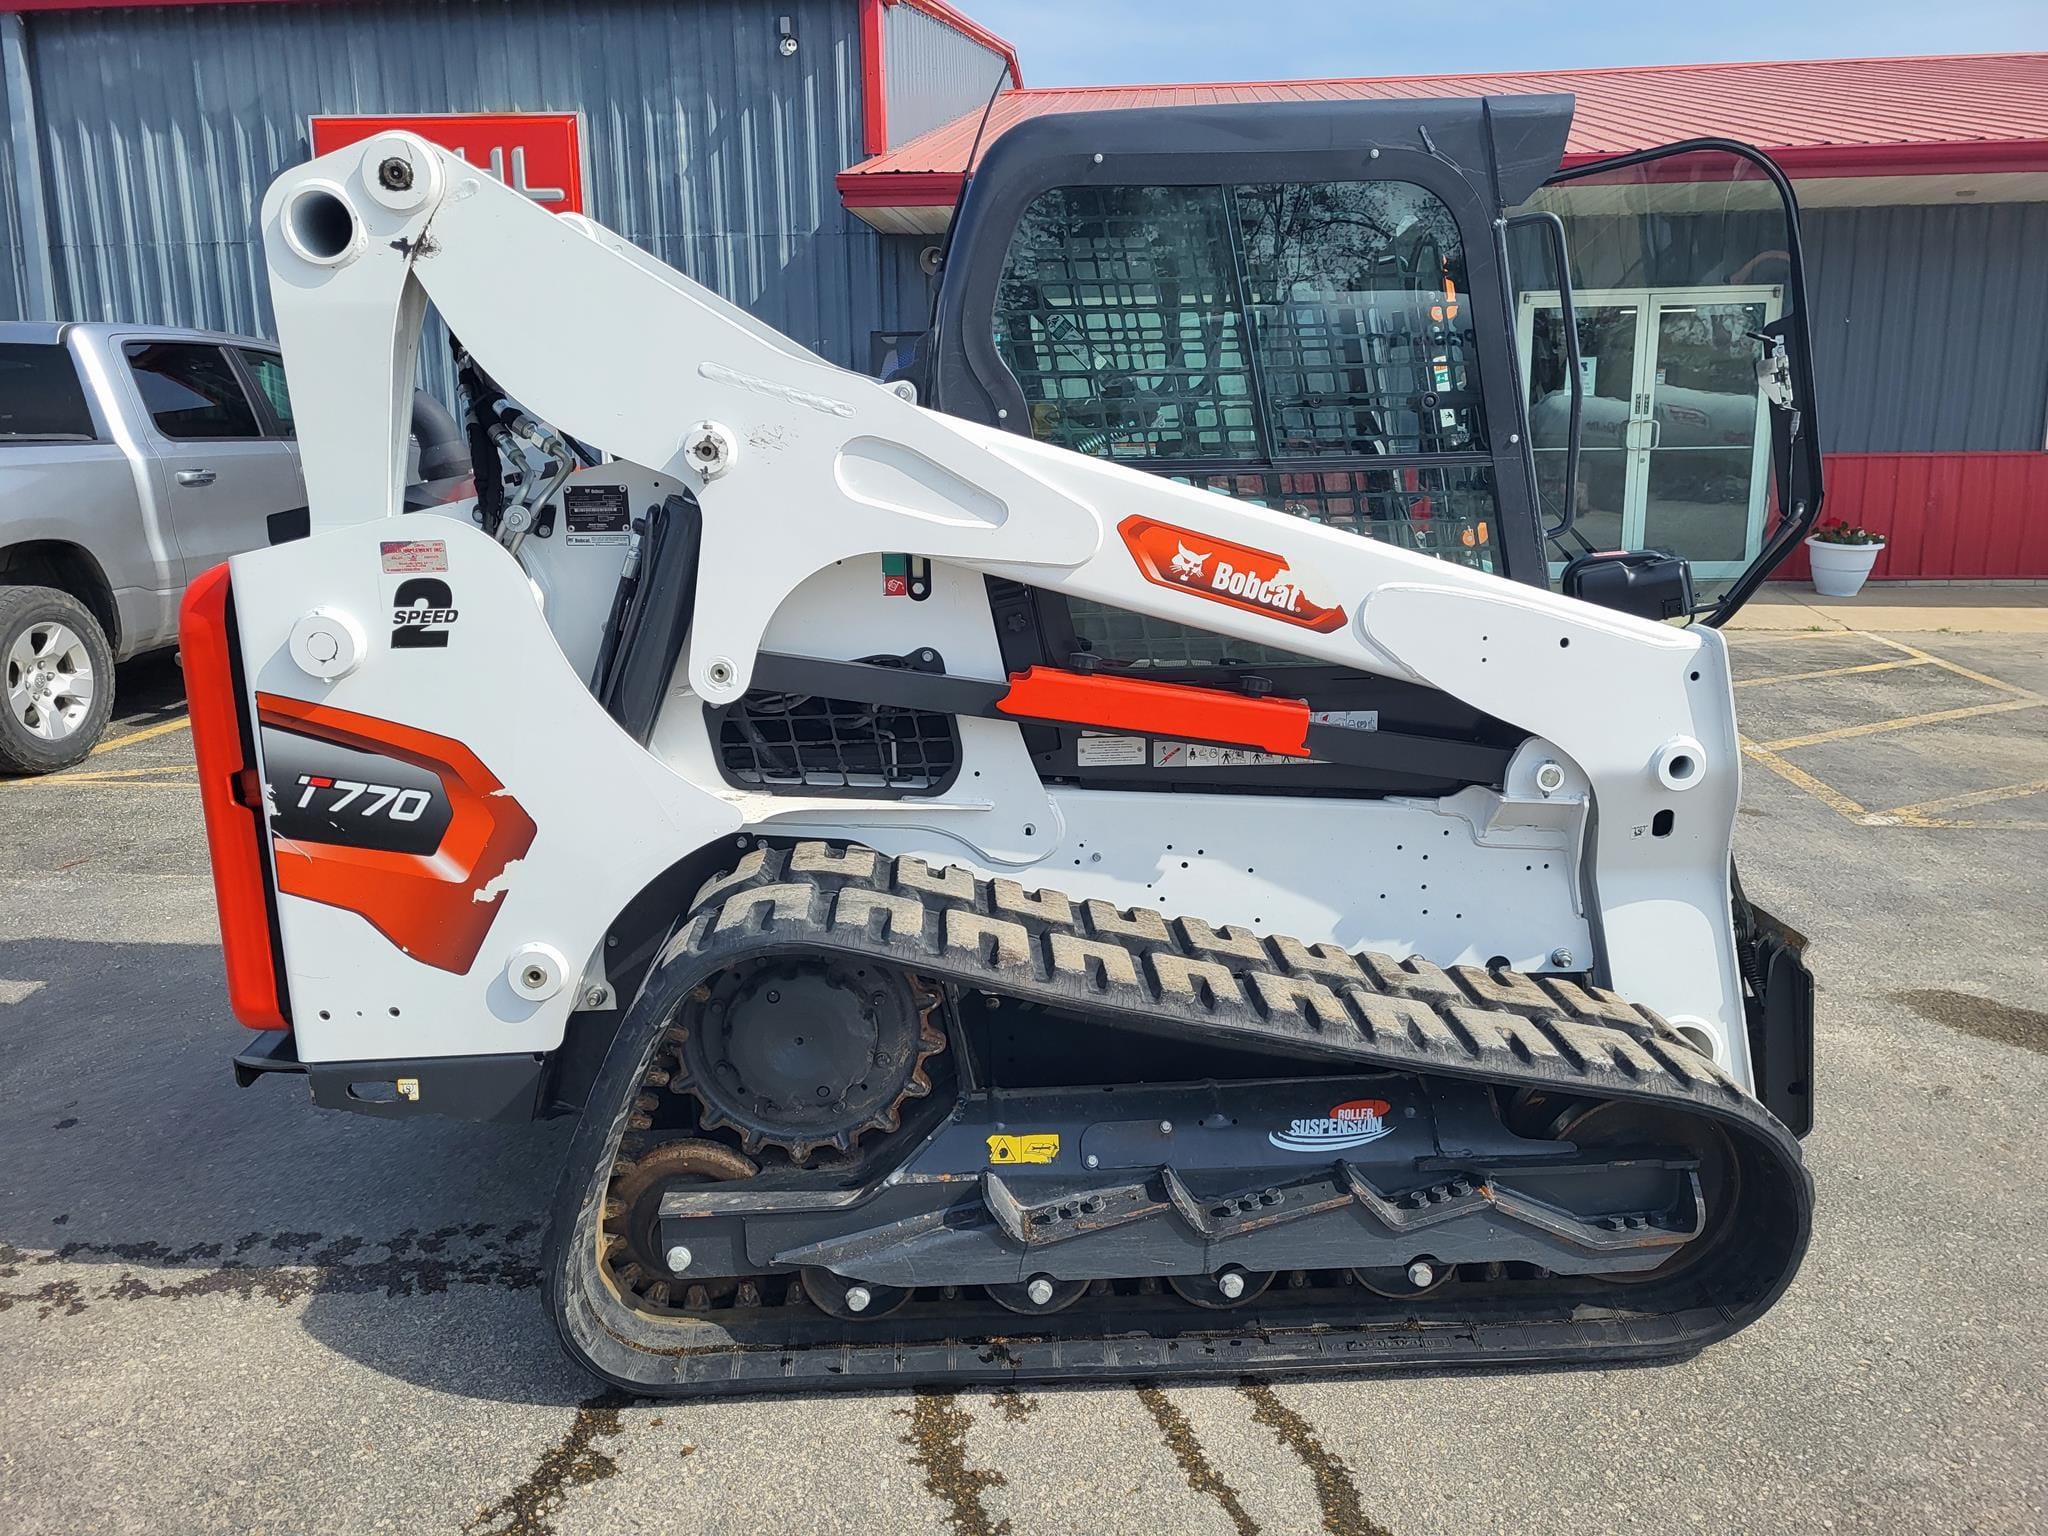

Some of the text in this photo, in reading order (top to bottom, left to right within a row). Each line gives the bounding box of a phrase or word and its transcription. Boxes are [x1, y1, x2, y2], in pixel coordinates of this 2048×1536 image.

[1211, 561, 1302, 612] Bobcat
[390, 577, 453, 649] 2
[392, 609, 459, 625] SPEED
[296, 774, 433, 822] T770
[1290, 1117, 1383, 1137] SUSPENSION
[1337, 1108, 1375, 1121] ROLLER
